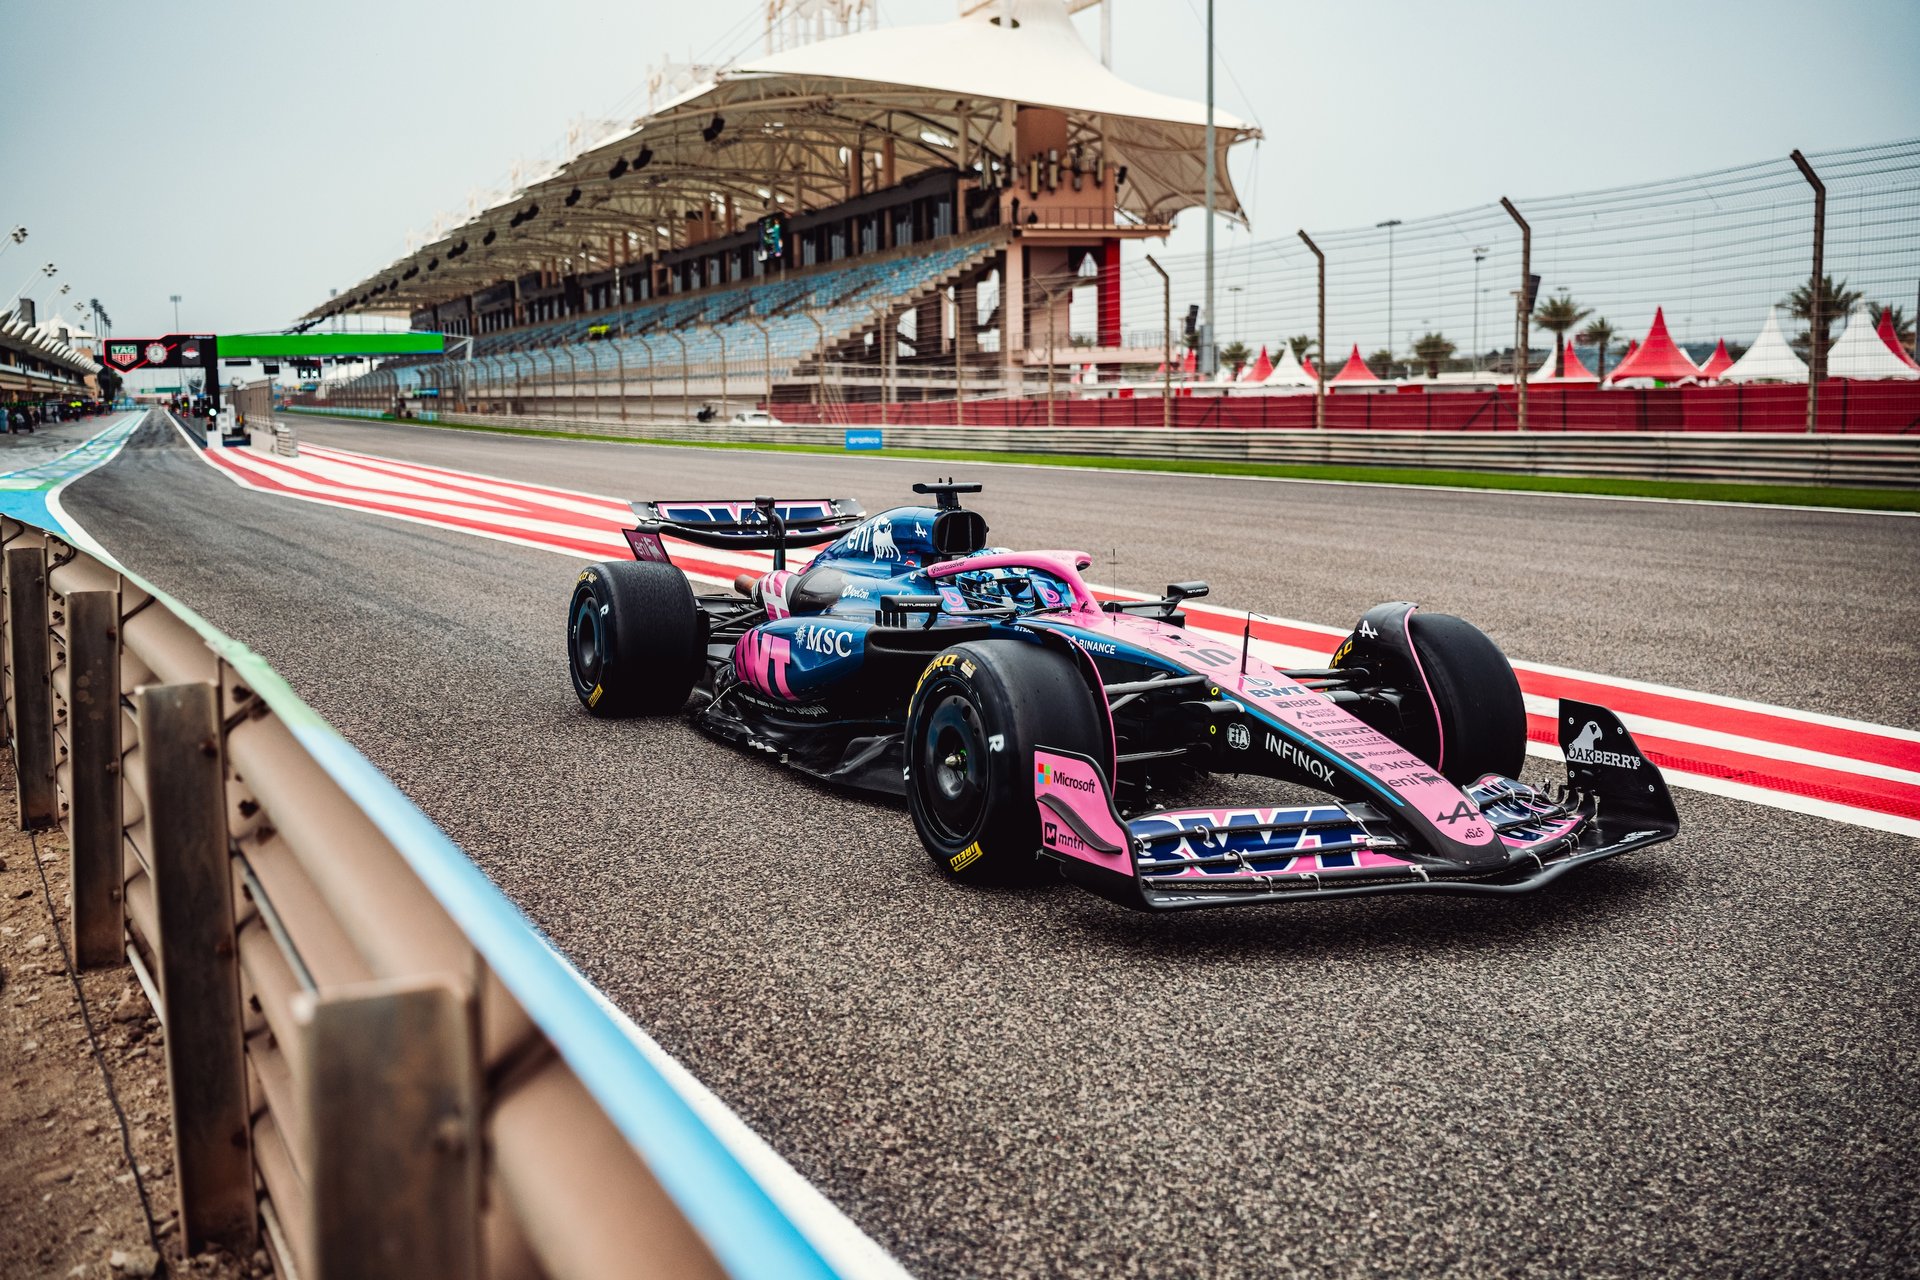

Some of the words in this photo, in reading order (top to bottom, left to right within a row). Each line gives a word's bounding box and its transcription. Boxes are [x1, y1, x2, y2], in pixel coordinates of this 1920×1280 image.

[113, 345, 136, 353] TAG
[634, 536, 652, 557] eni
[847, 526, 871, 552] eni
[806, 625, 853, 657] MSC
[1078, 639, 1117, 655] BINANCE
[1180, 648, 1237, 667] 10
[1247, 686, 1305, 698] BWT
[1289, 698, 1322, 709] BRB
[1312, 718, 1358, 726] BINANCE
[1312, 726, 1374, 738] PIRELLI
[1265, 732, 1336, 787] INFINOX
[1363, 748, 1409, 758] Microsoft
[1566, 746, 1640, 770] OAKBERRY
[1383, 759, 1427, 771] MSC
[1053, 770, 1095, 794] Microsoft
[1388, 774, 1421, 788] eni
[1058, 833, 1084, 851] mntn
